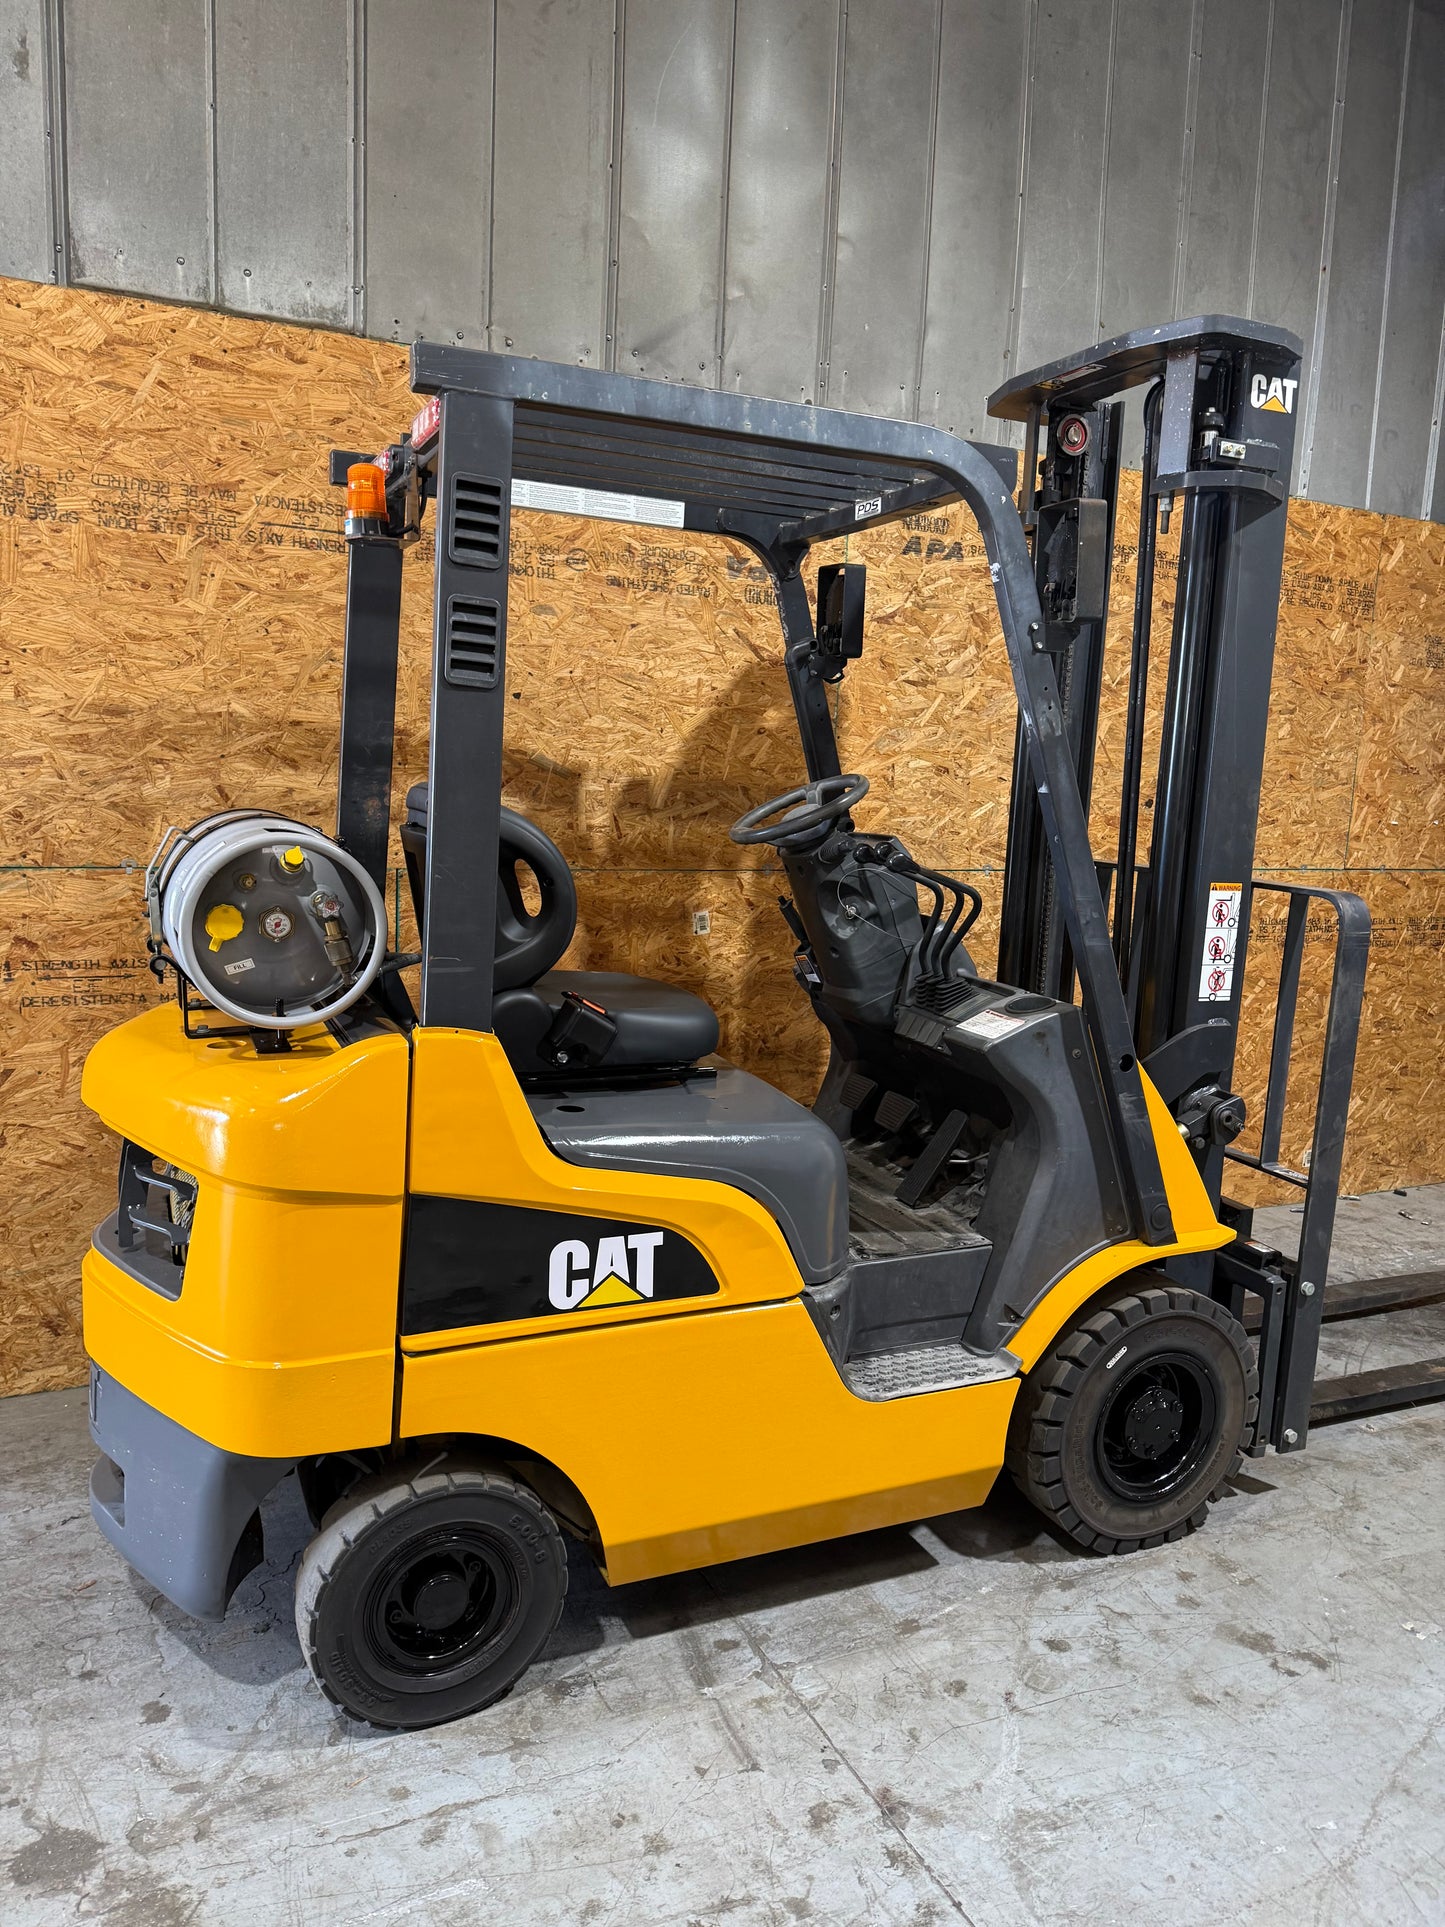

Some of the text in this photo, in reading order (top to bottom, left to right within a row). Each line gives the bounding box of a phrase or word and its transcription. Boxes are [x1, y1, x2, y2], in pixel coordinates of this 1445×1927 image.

[1250, 373, 1298, 415] CAT
[91, 473, 237, 503] MAY BE REQUIRED
[27, 506, 79, 524] SPACE
[857, 499, 880, 515] PDS
[98, 515, 232, 541] THIS SIDE DOWN
[292, 513, 320, 527] EJE
[247, 530, 347, 554] RENGTH AXIS
[901, 535, 964, 562] APA
[640, 544, 696, 562] EXPOSURE
[1315, 575, 1333, 585] DOWN
[676, 584, 711, 598] RATED
[1217, 883, 1241, 892] WARNING
[21, 959, 100, 972] STRENGTH
[110, 958, 149, 970] AXIS
[233, 962, 247, 971] FILL
[548, 1231, 664, 1310] CAT
